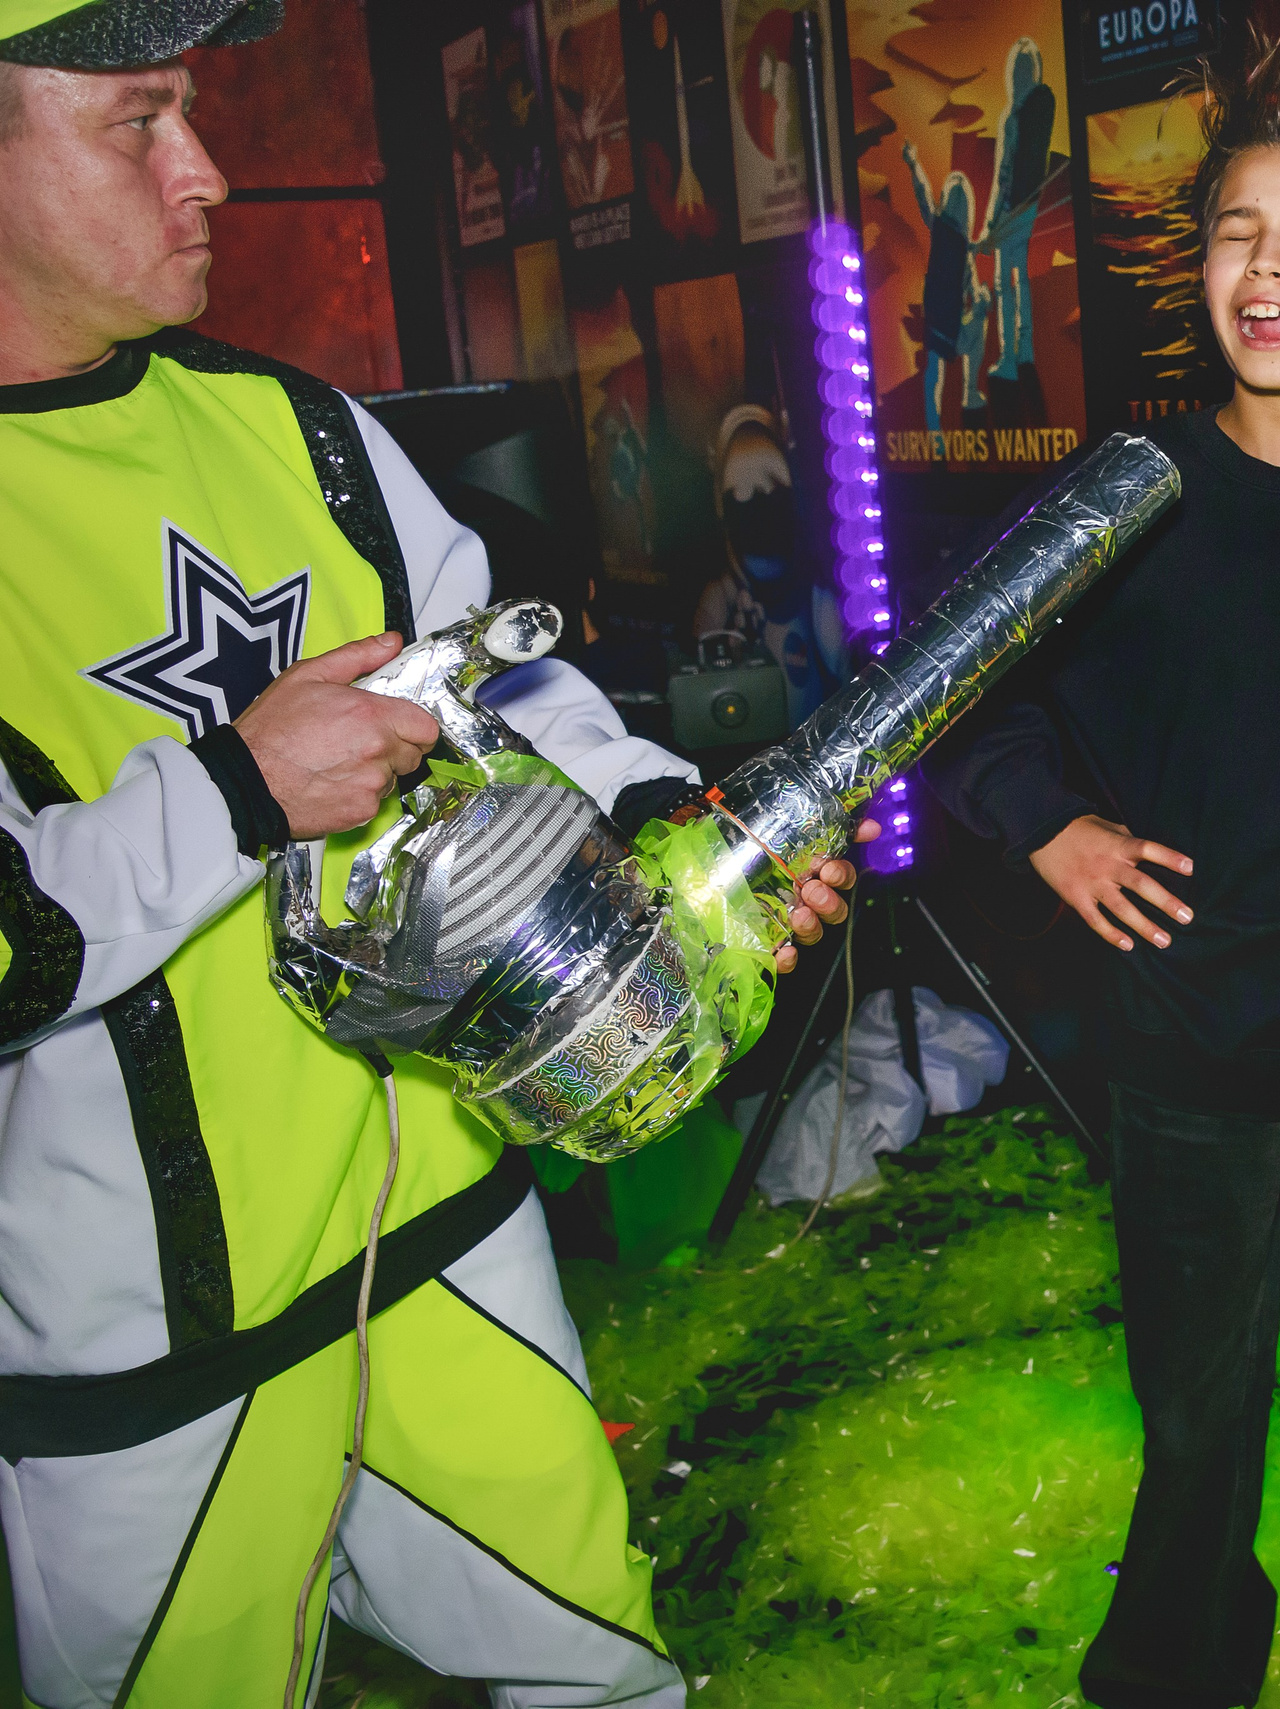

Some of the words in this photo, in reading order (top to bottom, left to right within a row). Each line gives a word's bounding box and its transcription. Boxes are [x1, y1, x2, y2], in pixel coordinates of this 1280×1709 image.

[1099, 0, 1198, 48] EUROPA
[886, 429, 990, 462] SURVEYORS
[993, 427, 1079, 462] WANTED
